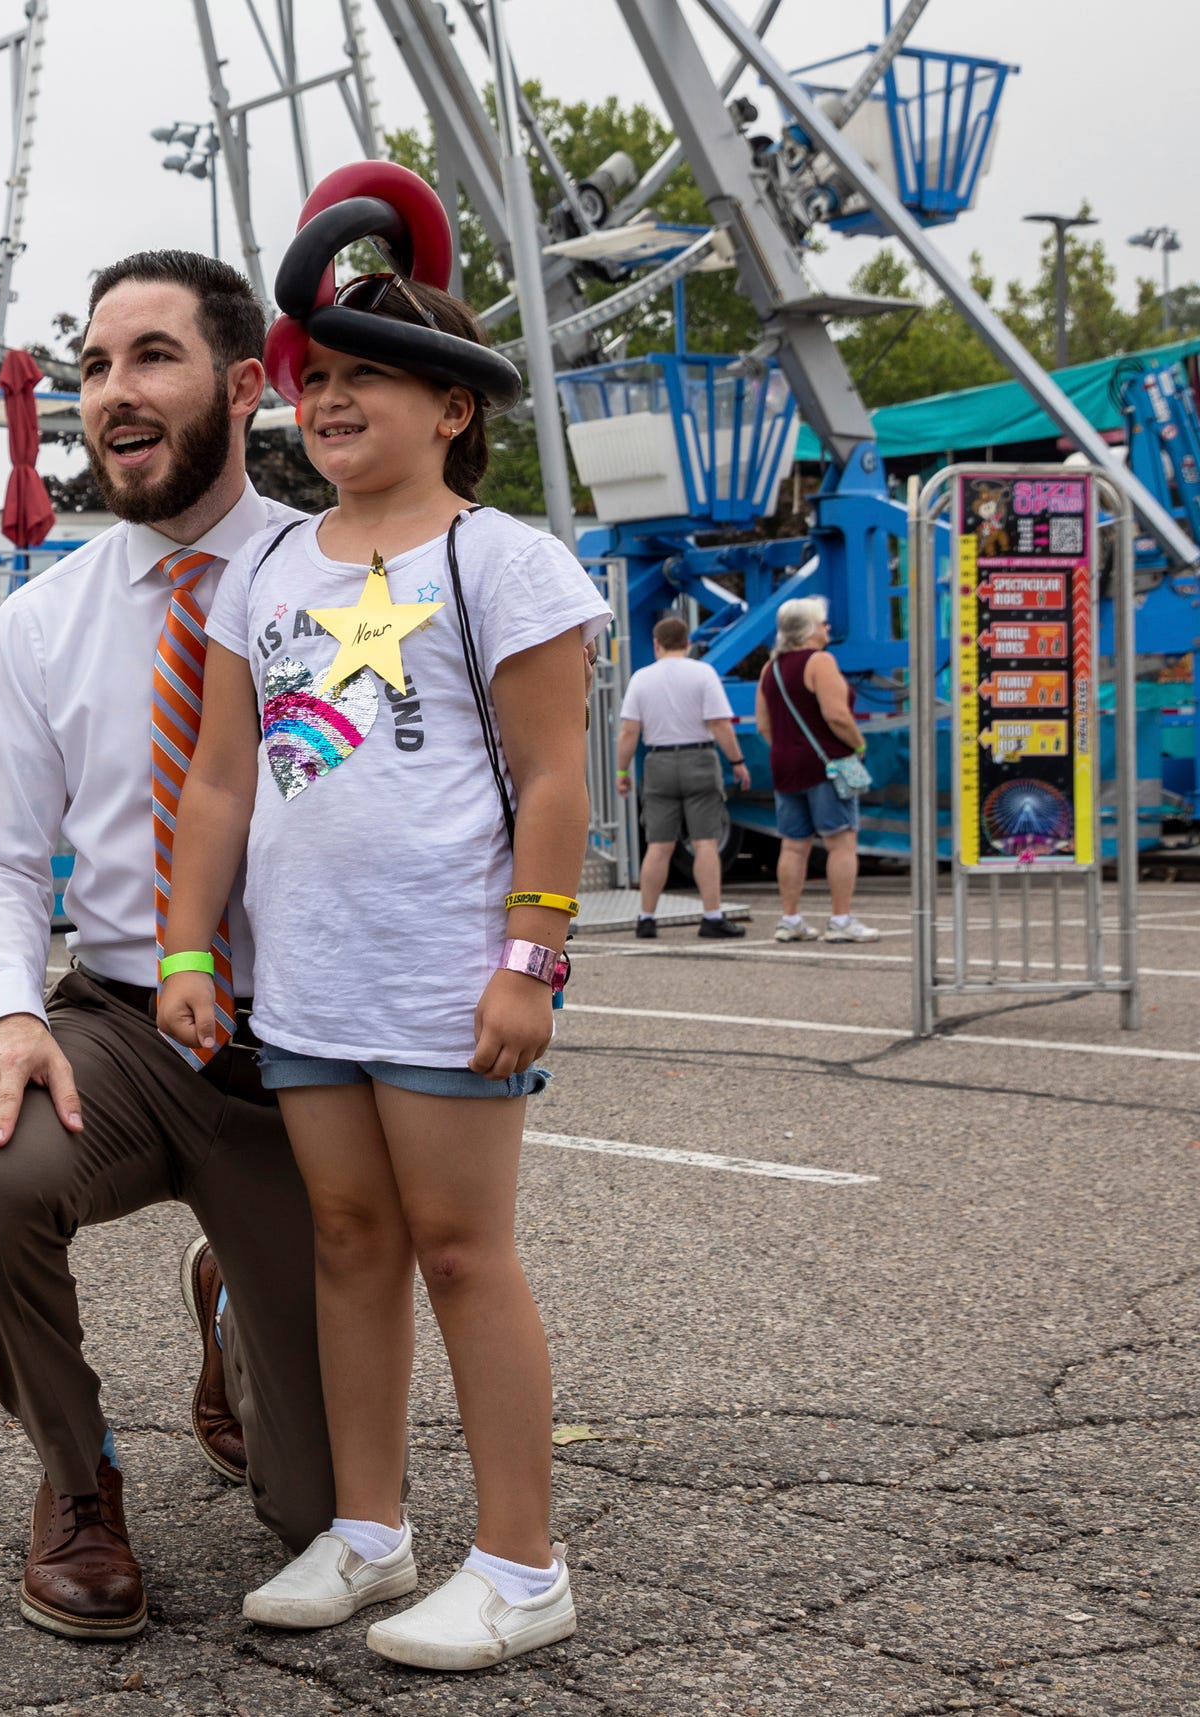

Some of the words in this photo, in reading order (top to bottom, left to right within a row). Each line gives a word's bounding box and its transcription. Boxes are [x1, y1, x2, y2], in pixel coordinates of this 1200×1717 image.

[1013, 481, 1083, 498] SIZE
[1013, 497, 1048, 515] UP
[993, 578, 1061, 591] SPECTACULAR
[993, 592, 1024, 605] RIDES
[257, 620, 282, 659] IS
[352, 622, 392, 647] Nour
[995, 626, 1030, 640] THRILL
[995, 641, 1025, 654] RIDES
[997, 689, 1027, 702] RIDES
[513, 894, 542, 904] AUGUST
